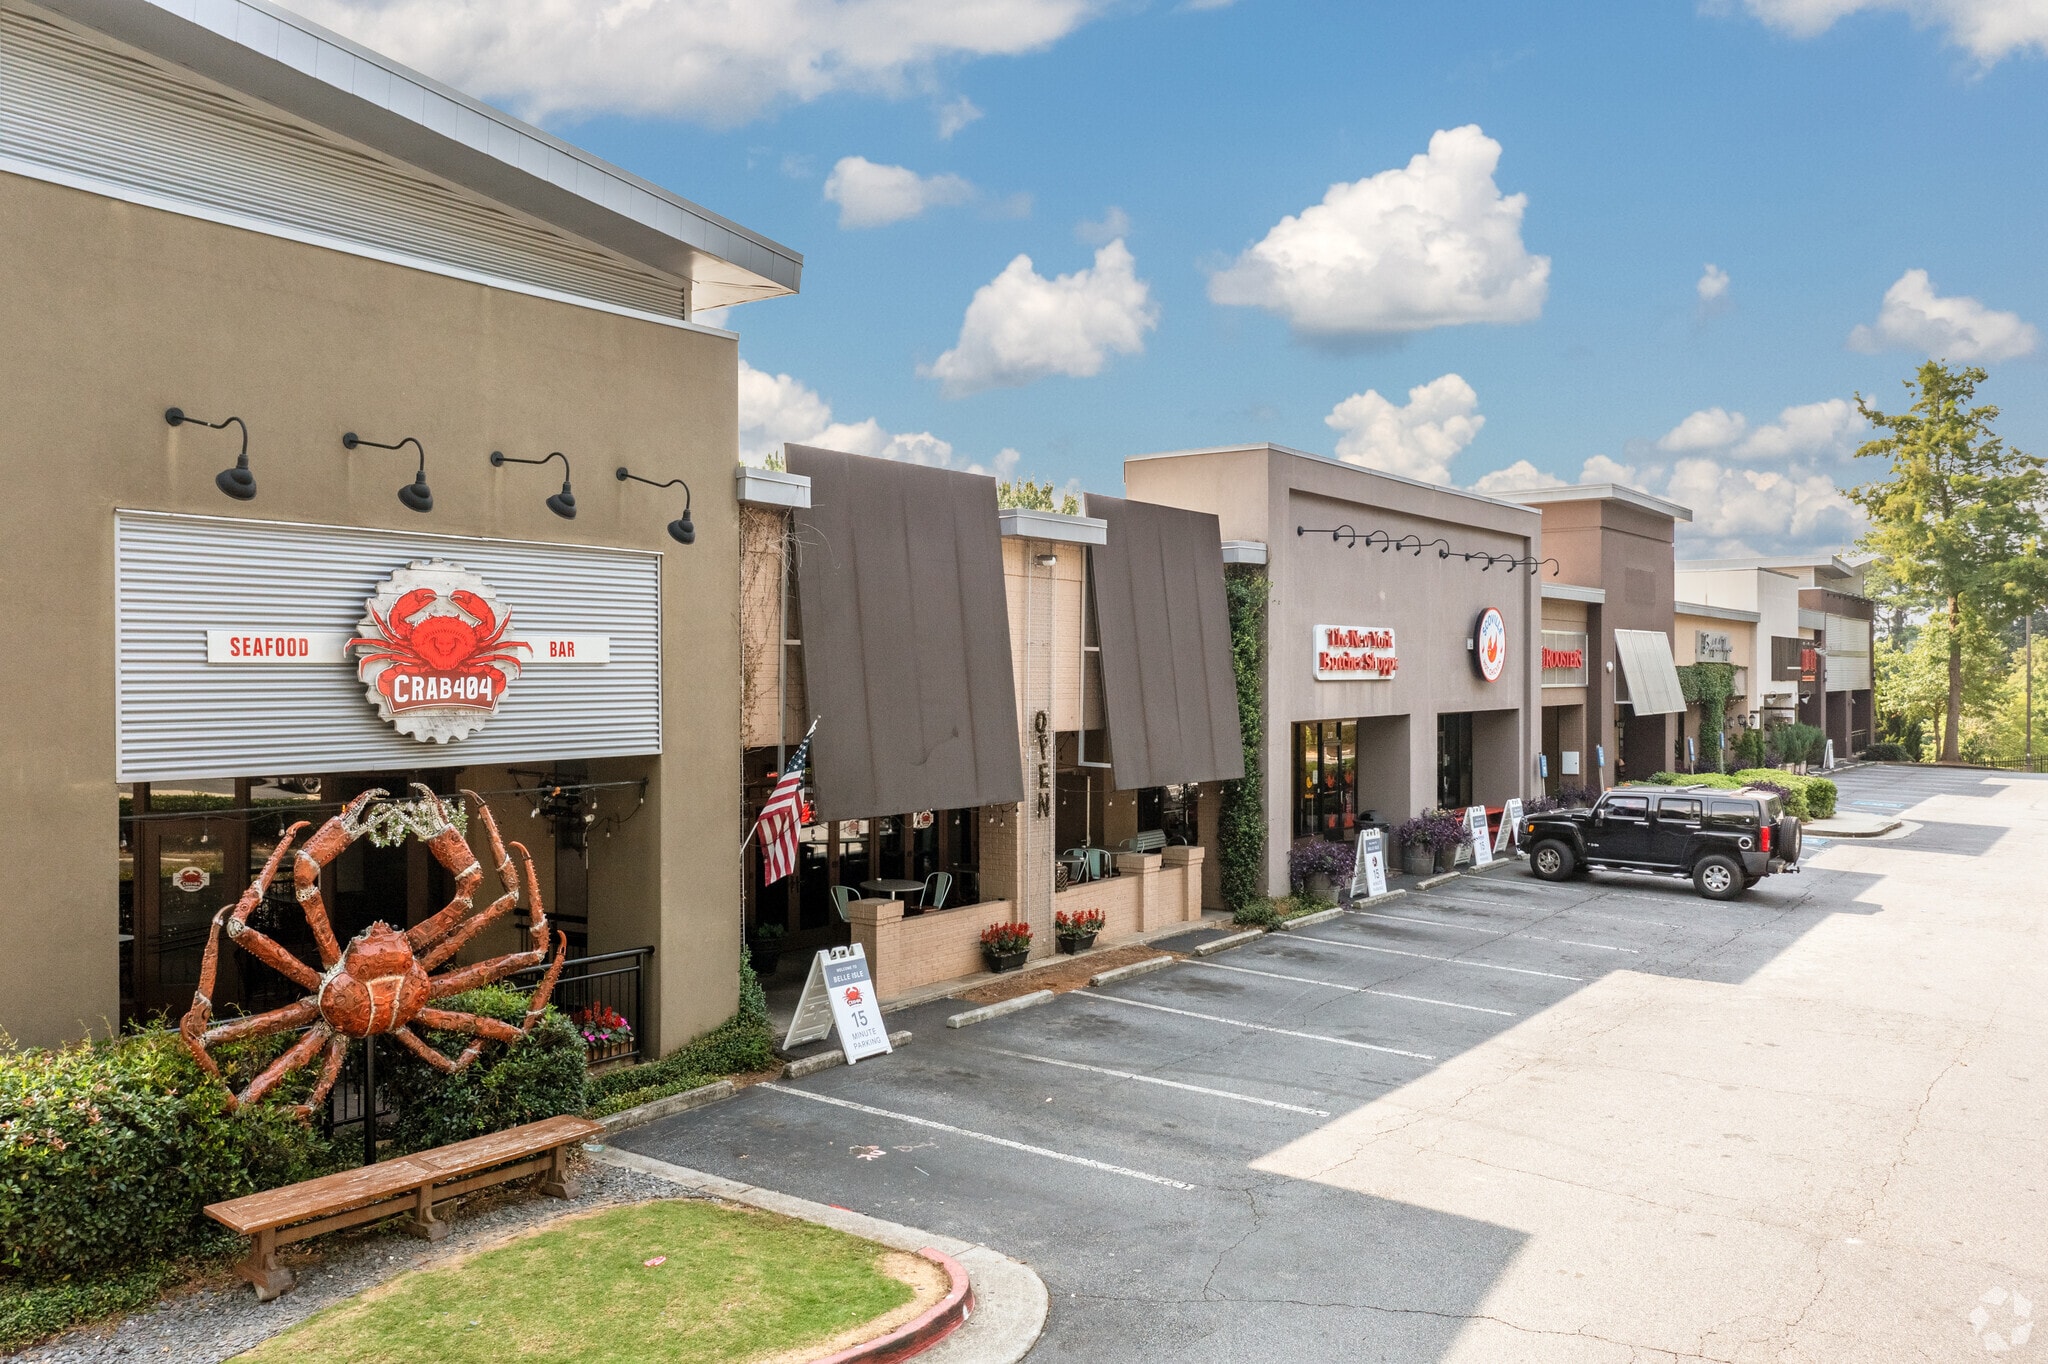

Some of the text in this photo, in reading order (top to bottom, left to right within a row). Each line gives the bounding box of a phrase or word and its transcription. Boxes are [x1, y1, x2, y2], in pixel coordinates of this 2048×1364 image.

[1482, 613, 1503, 636] SCOVILLE
[230, 637, 309, 657] SEAFOOD
[1326, 628, 1393, 648] The New York
[549, 641, 575, 657] BAR
[1319, 652, 1362, 671] Butcher
[394, 674, 493, 703] CRAB404
[1035, 710, 1050, 819] OPEN
[833, 970, 864, 984] BELLE ISLE
[851, 1010, 868, 1028] 15
[852, 1027, 877, 1040] MINUTE
[853, 1037, 881, 1050] PARKING
